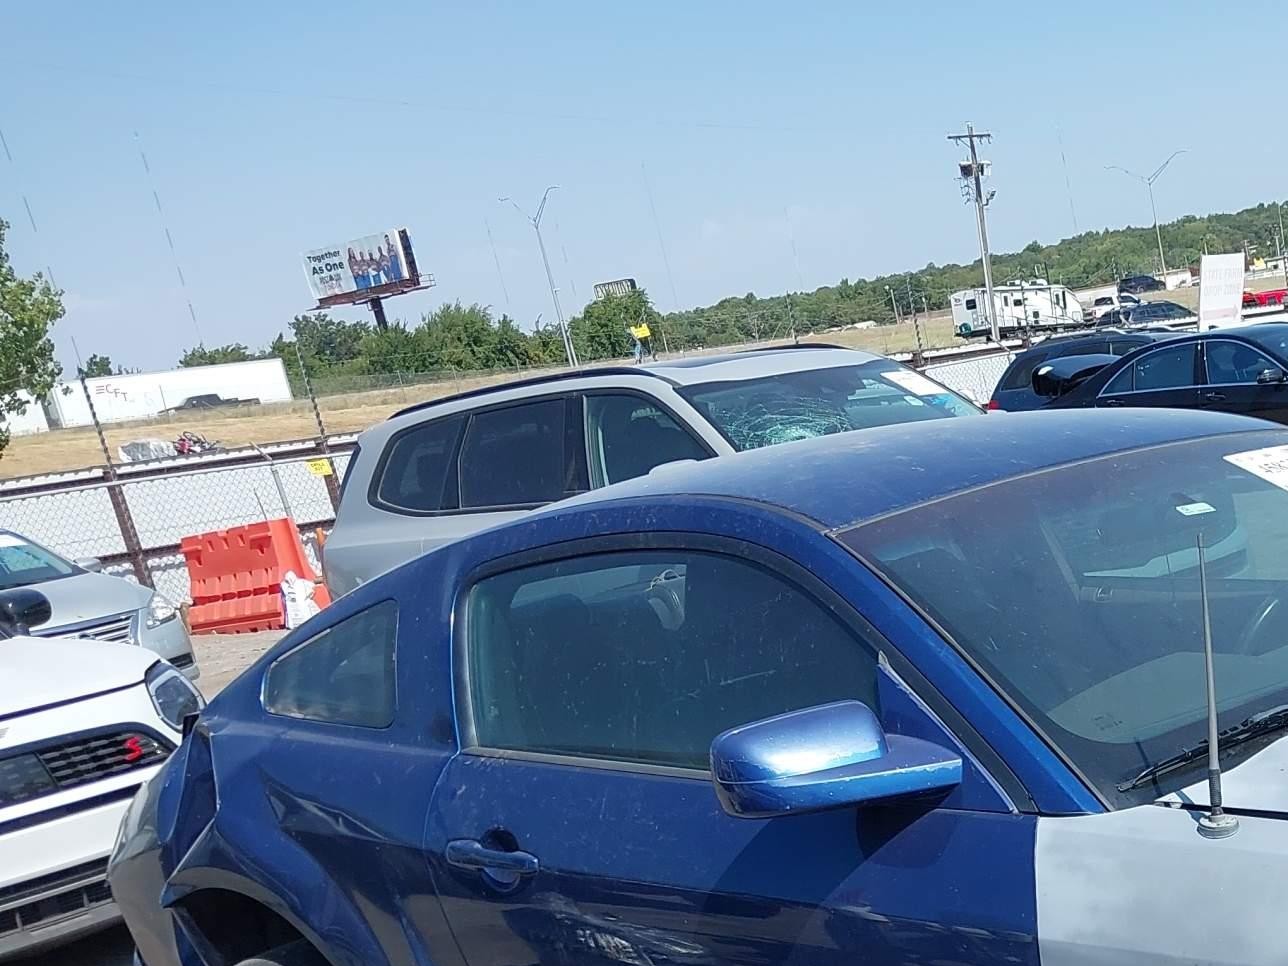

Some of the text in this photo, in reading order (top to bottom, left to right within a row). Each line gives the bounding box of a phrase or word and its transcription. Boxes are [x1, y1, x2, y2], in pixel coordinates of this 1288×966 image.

[307, 250, 340, 263] Together
[312, 262, 344, 276] As One
